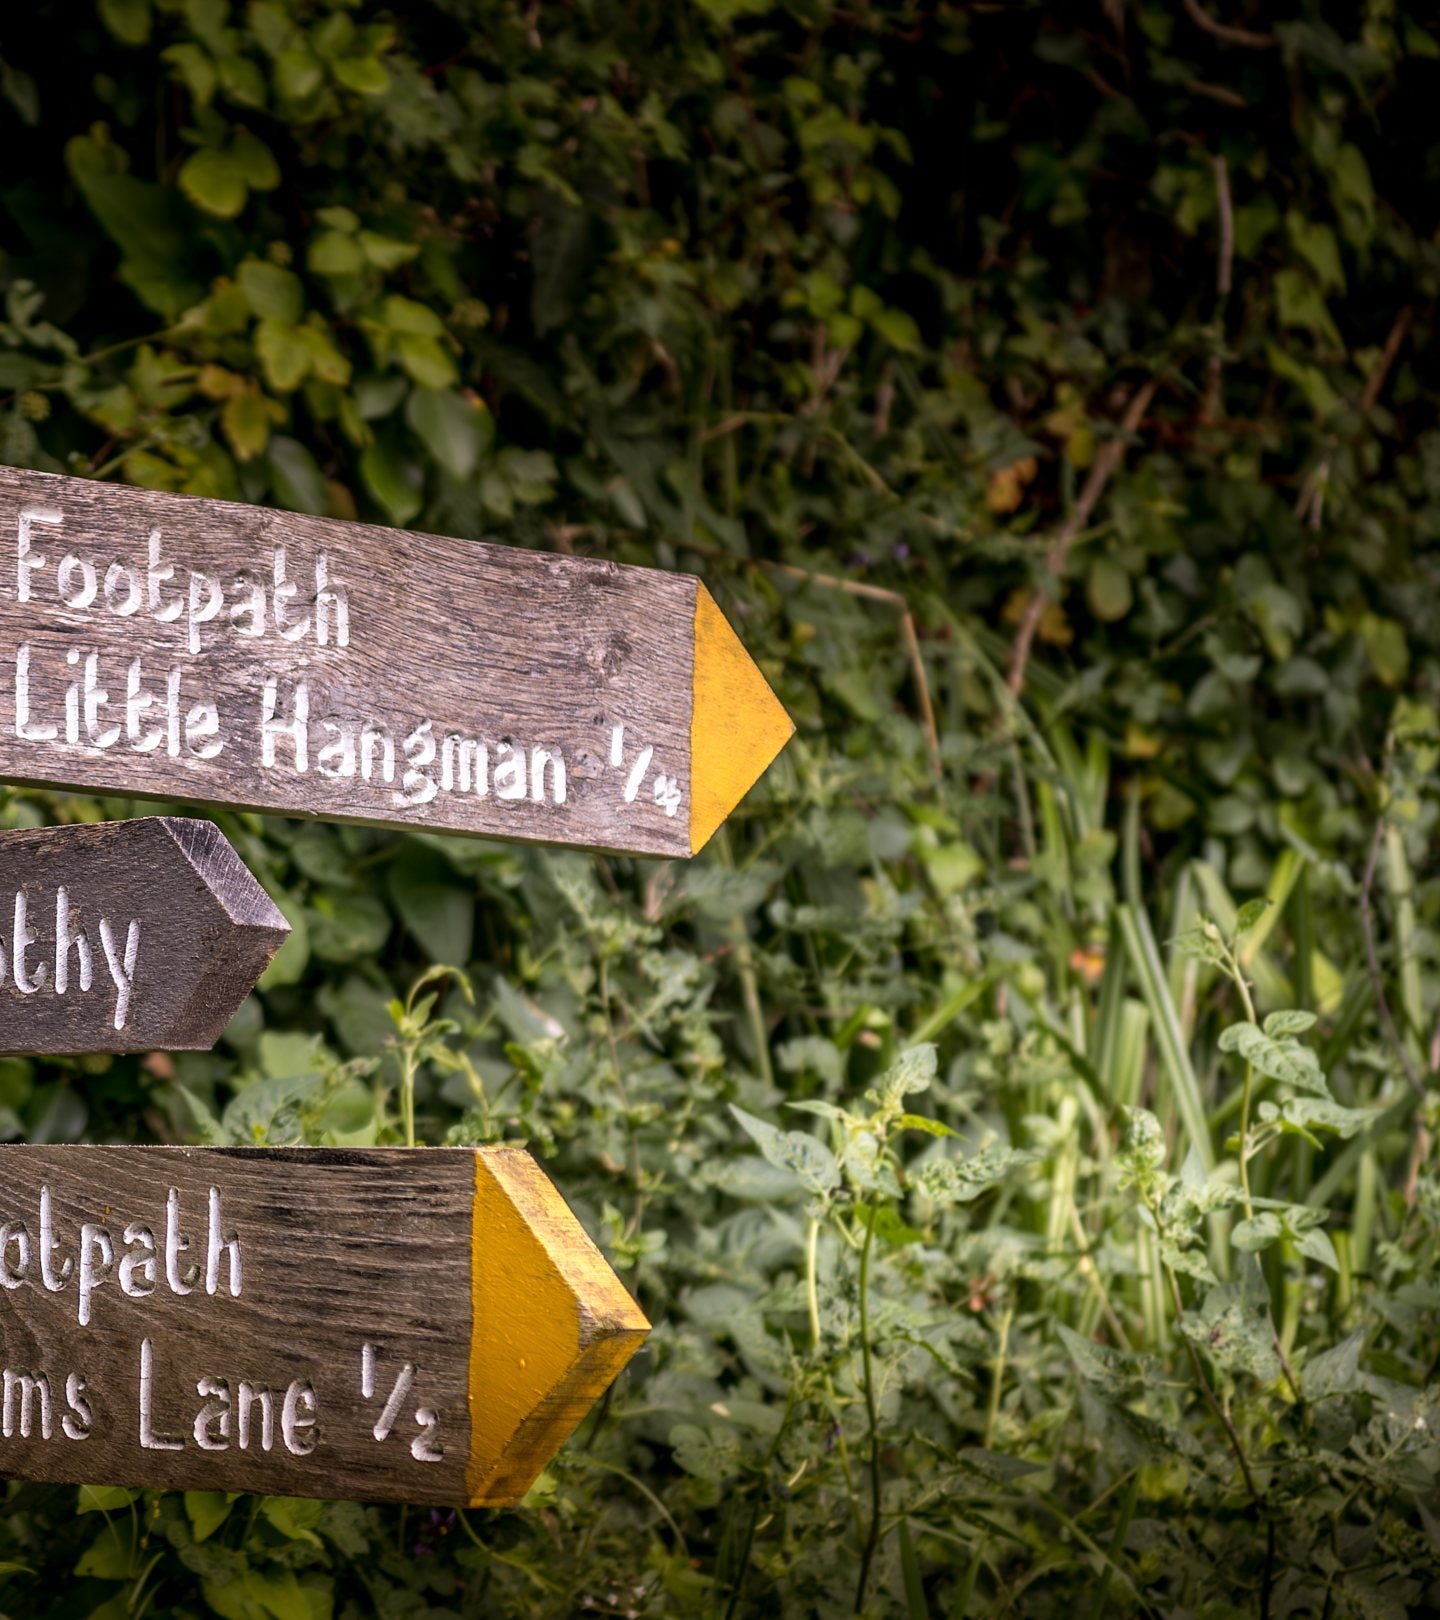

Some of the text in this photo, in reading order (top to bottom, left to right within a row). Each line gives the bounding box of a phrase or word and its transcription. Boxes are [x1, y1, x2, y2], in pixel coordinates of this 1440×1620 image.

[16, 504, 351, 655] Footpath
[15, 640, 224, 760] Little
[261, 673, 567, 805] Hangman
[139, 1336, 321, 1456] Lane
